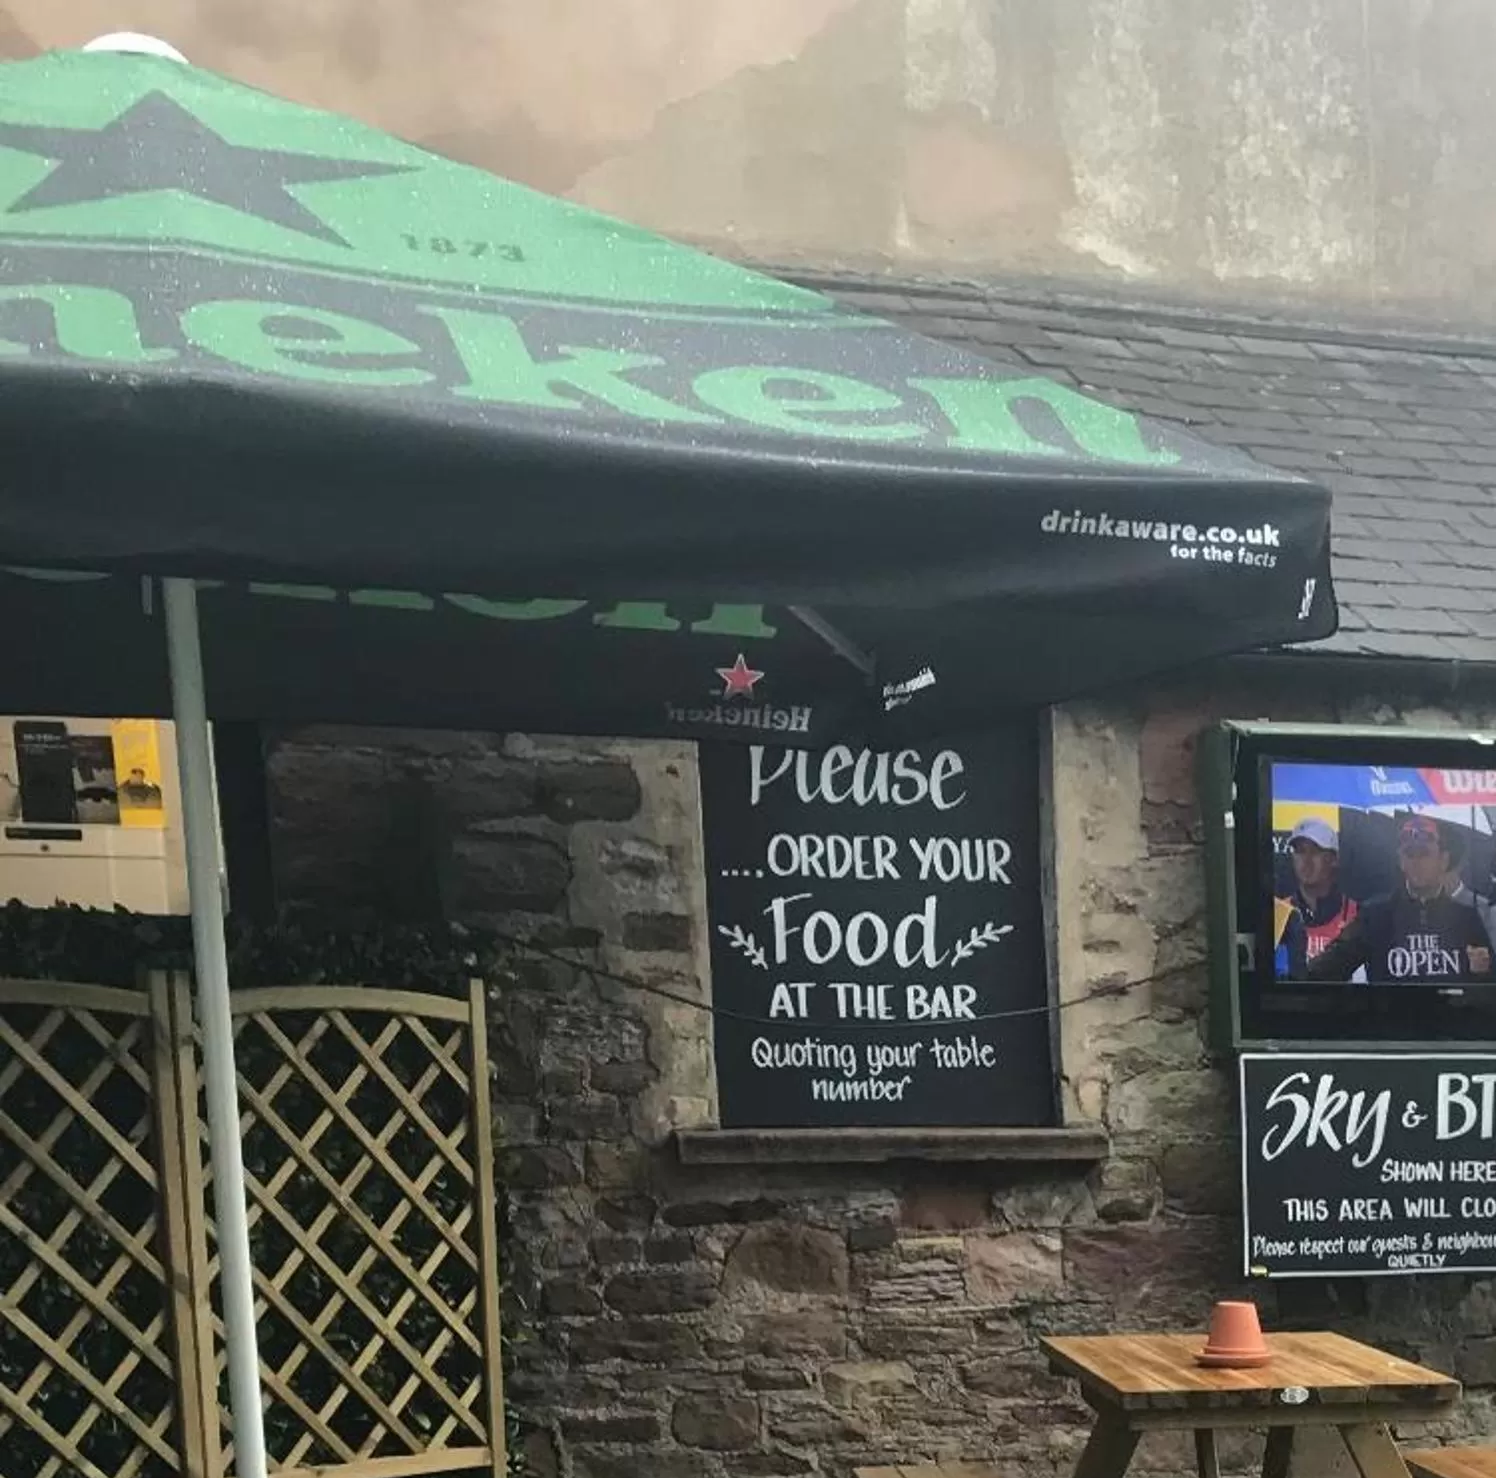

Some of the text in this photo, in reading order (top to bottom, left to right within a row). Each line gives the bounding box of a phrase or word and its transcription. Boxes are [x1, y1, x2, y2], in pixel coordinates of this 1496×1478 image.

[400, 233, 525, 262] 1873
[1041, 510, 1280, 547] drinkaware.co.uk
[1170, 544, 1277, 568] for the facts
[750, 744, 967, 809] Please
[909, 837, 1012, 885] YOUR
[764, 893, 949, 968] Food
[1407, 934, 1439, 950] THE
[1388, 947, 1460, 977] OPEN
[769, 983, 977, 1020] AT THE BAR
[751, 1036, 996, 1077] Quoting your table
[812, 1075, 913, 1101] number
[1262, 1072, 1391, 1168] Sky
[1402, 1101, 1428, 1128] &
[1380, 1158, 1443, 1183] SHOWN
[1283, 1198, 1329, 1222] THIS
[1339, 1198, 1393, 1222] AREA
[1404, 1197, 1452, 1218] WILL
[1253, 1235, 1297, 1258] Please
[1300, 1236, 1345, 1260] respect
[1347, 1235, 1372, 1254] our
[1372, 1233, 1417, 1259] guests
[1421, 1232, 1433, 1250] &
[1387, 1253, 1446, 1268] QUIETLY
